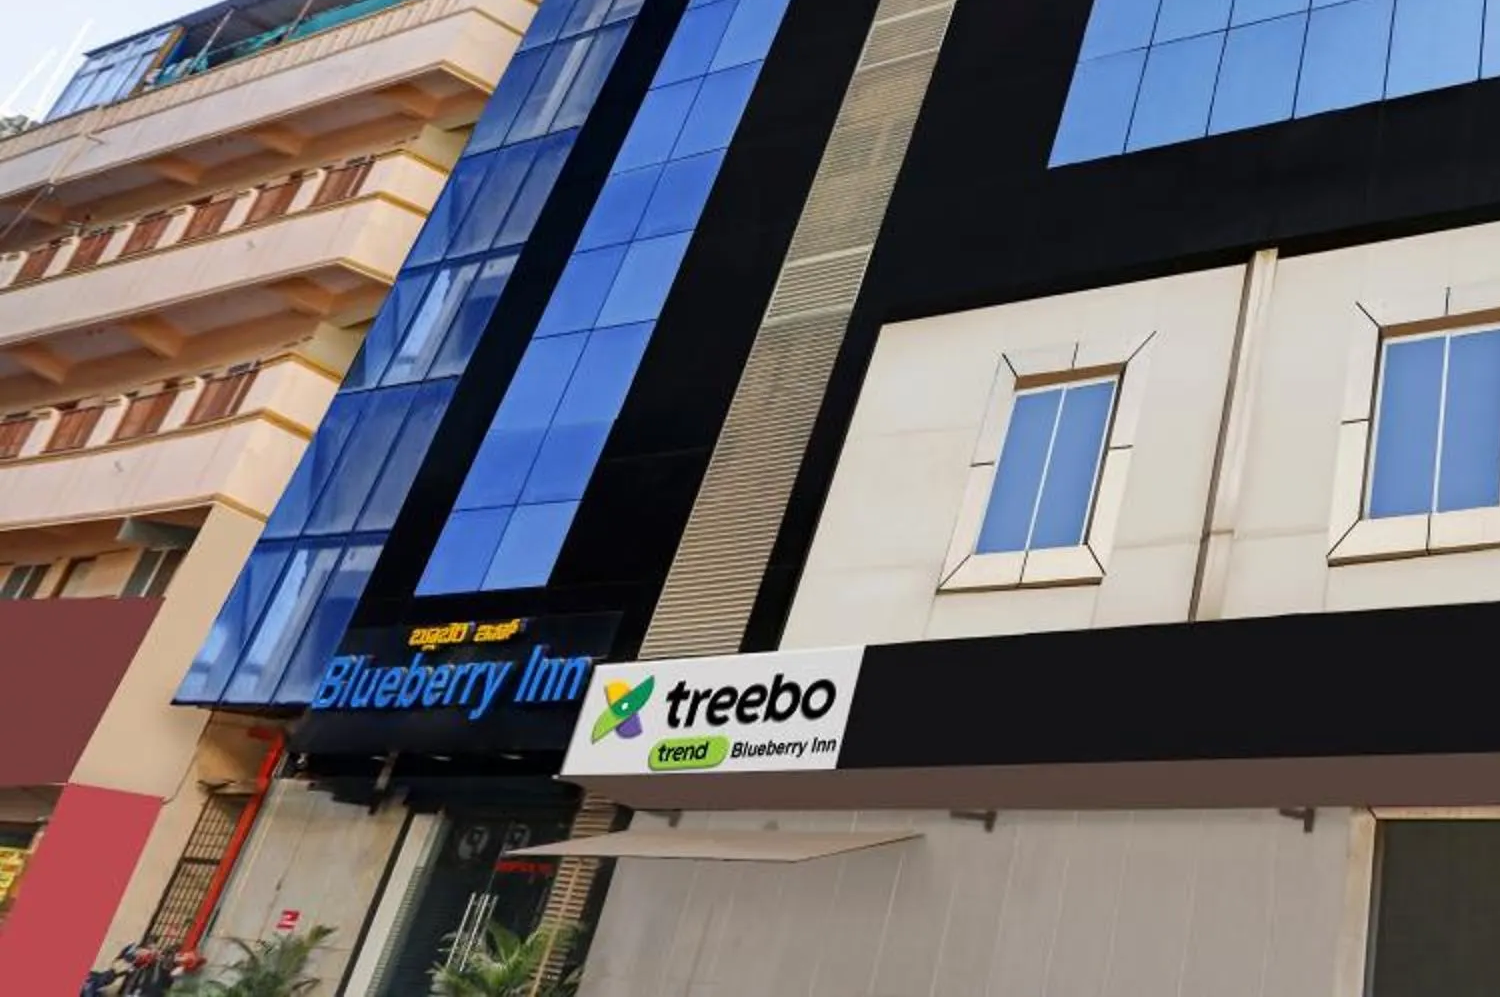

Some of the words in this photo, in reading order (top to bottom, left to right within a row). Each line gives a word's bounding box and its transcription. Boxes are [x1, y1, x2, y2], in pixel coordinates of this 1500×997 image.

[311, 653, 513, 720] Blueberry
[514, 644, 591, 702] Inn
[666, 673, 837, 728] treebo
[657, 741, 709, 762] trend
[730, 741, 808, 758] Blueberry
[811, 736, 837, 754] Inn
